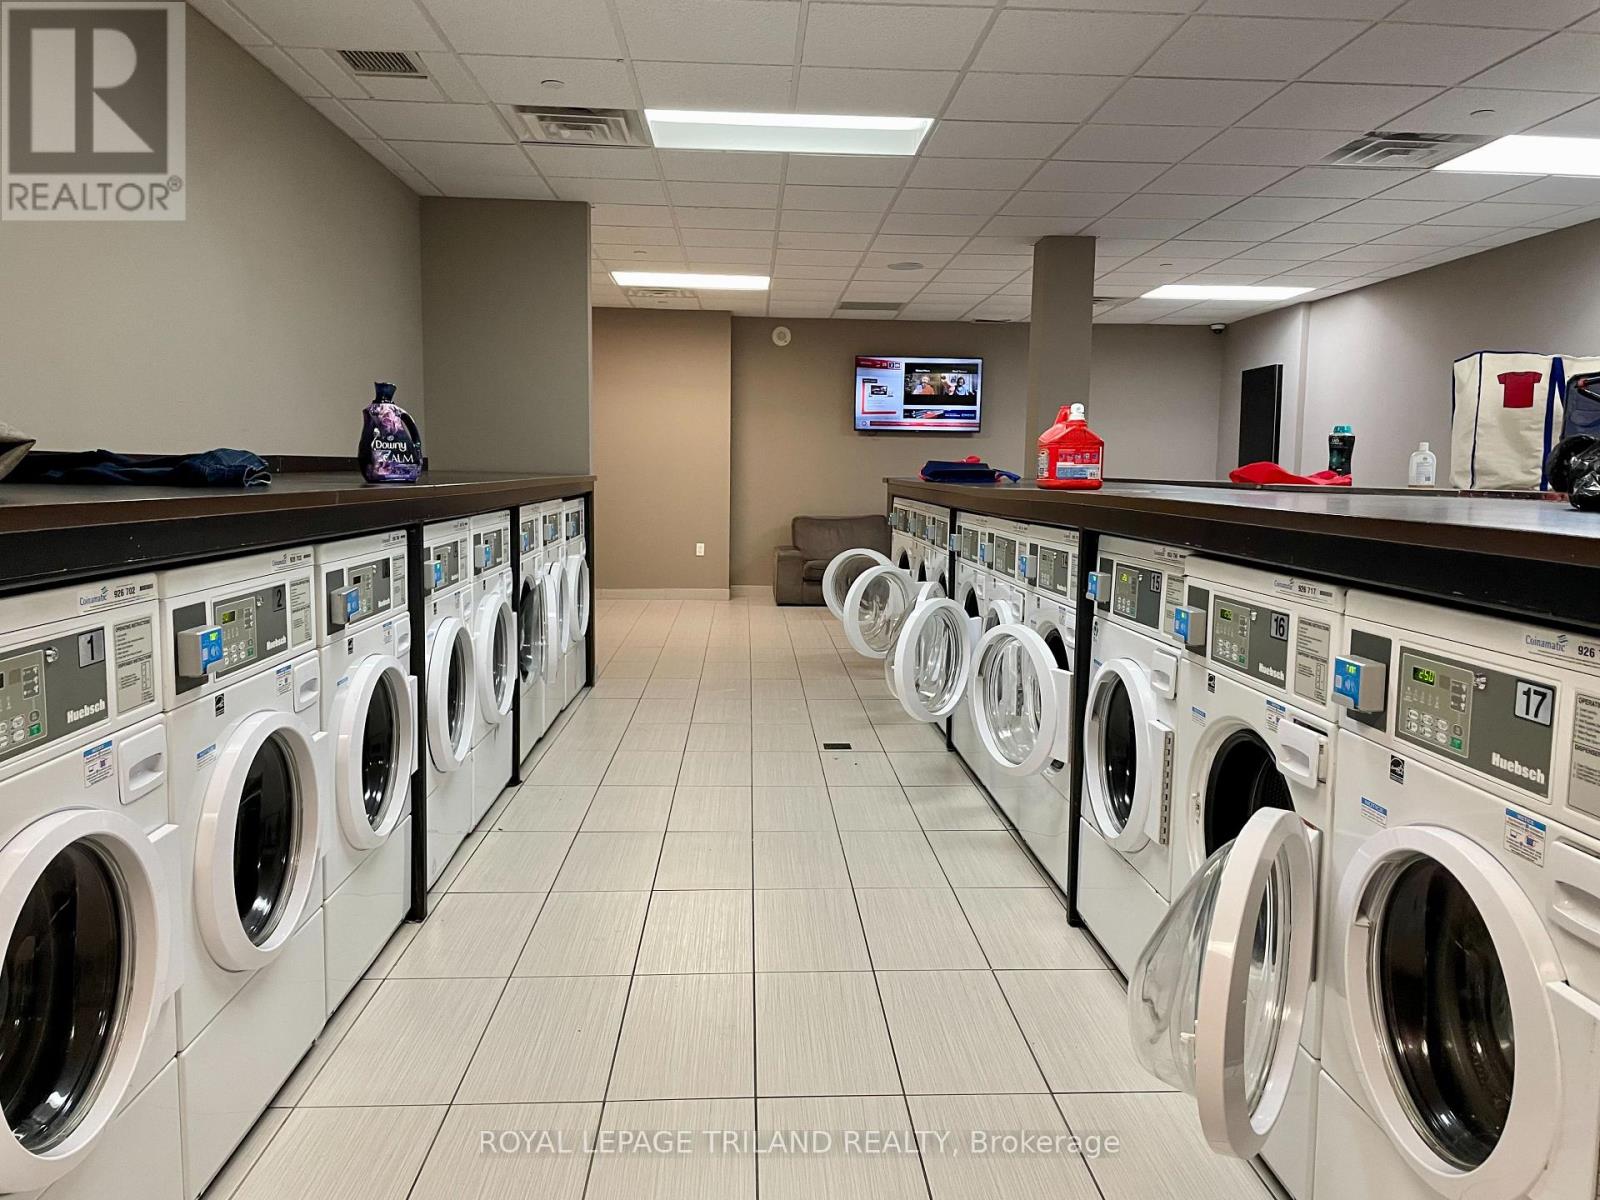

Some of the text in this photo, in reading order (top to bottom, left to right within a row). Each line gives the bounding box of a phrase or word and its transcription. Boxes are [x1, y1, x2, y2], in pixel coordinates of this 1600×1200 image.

[375, 440, 407, 452] Downy
[114, 589, 125, 598] 926
[126, 586, 136, 596] 702
[1152, 573, 1161, 591] 15
[276, 588, 283, 608] 2
[1273, 615, 1285, 637] 16
[86, 634, 95, 661] 1
[1525, 634, 1596, 658] Coinamatic 926
[66, 699, 106, 723] Huebsch
[1522, 686, 1547, 719] 17
[1491, 752, 1545, 784] Huebsch
